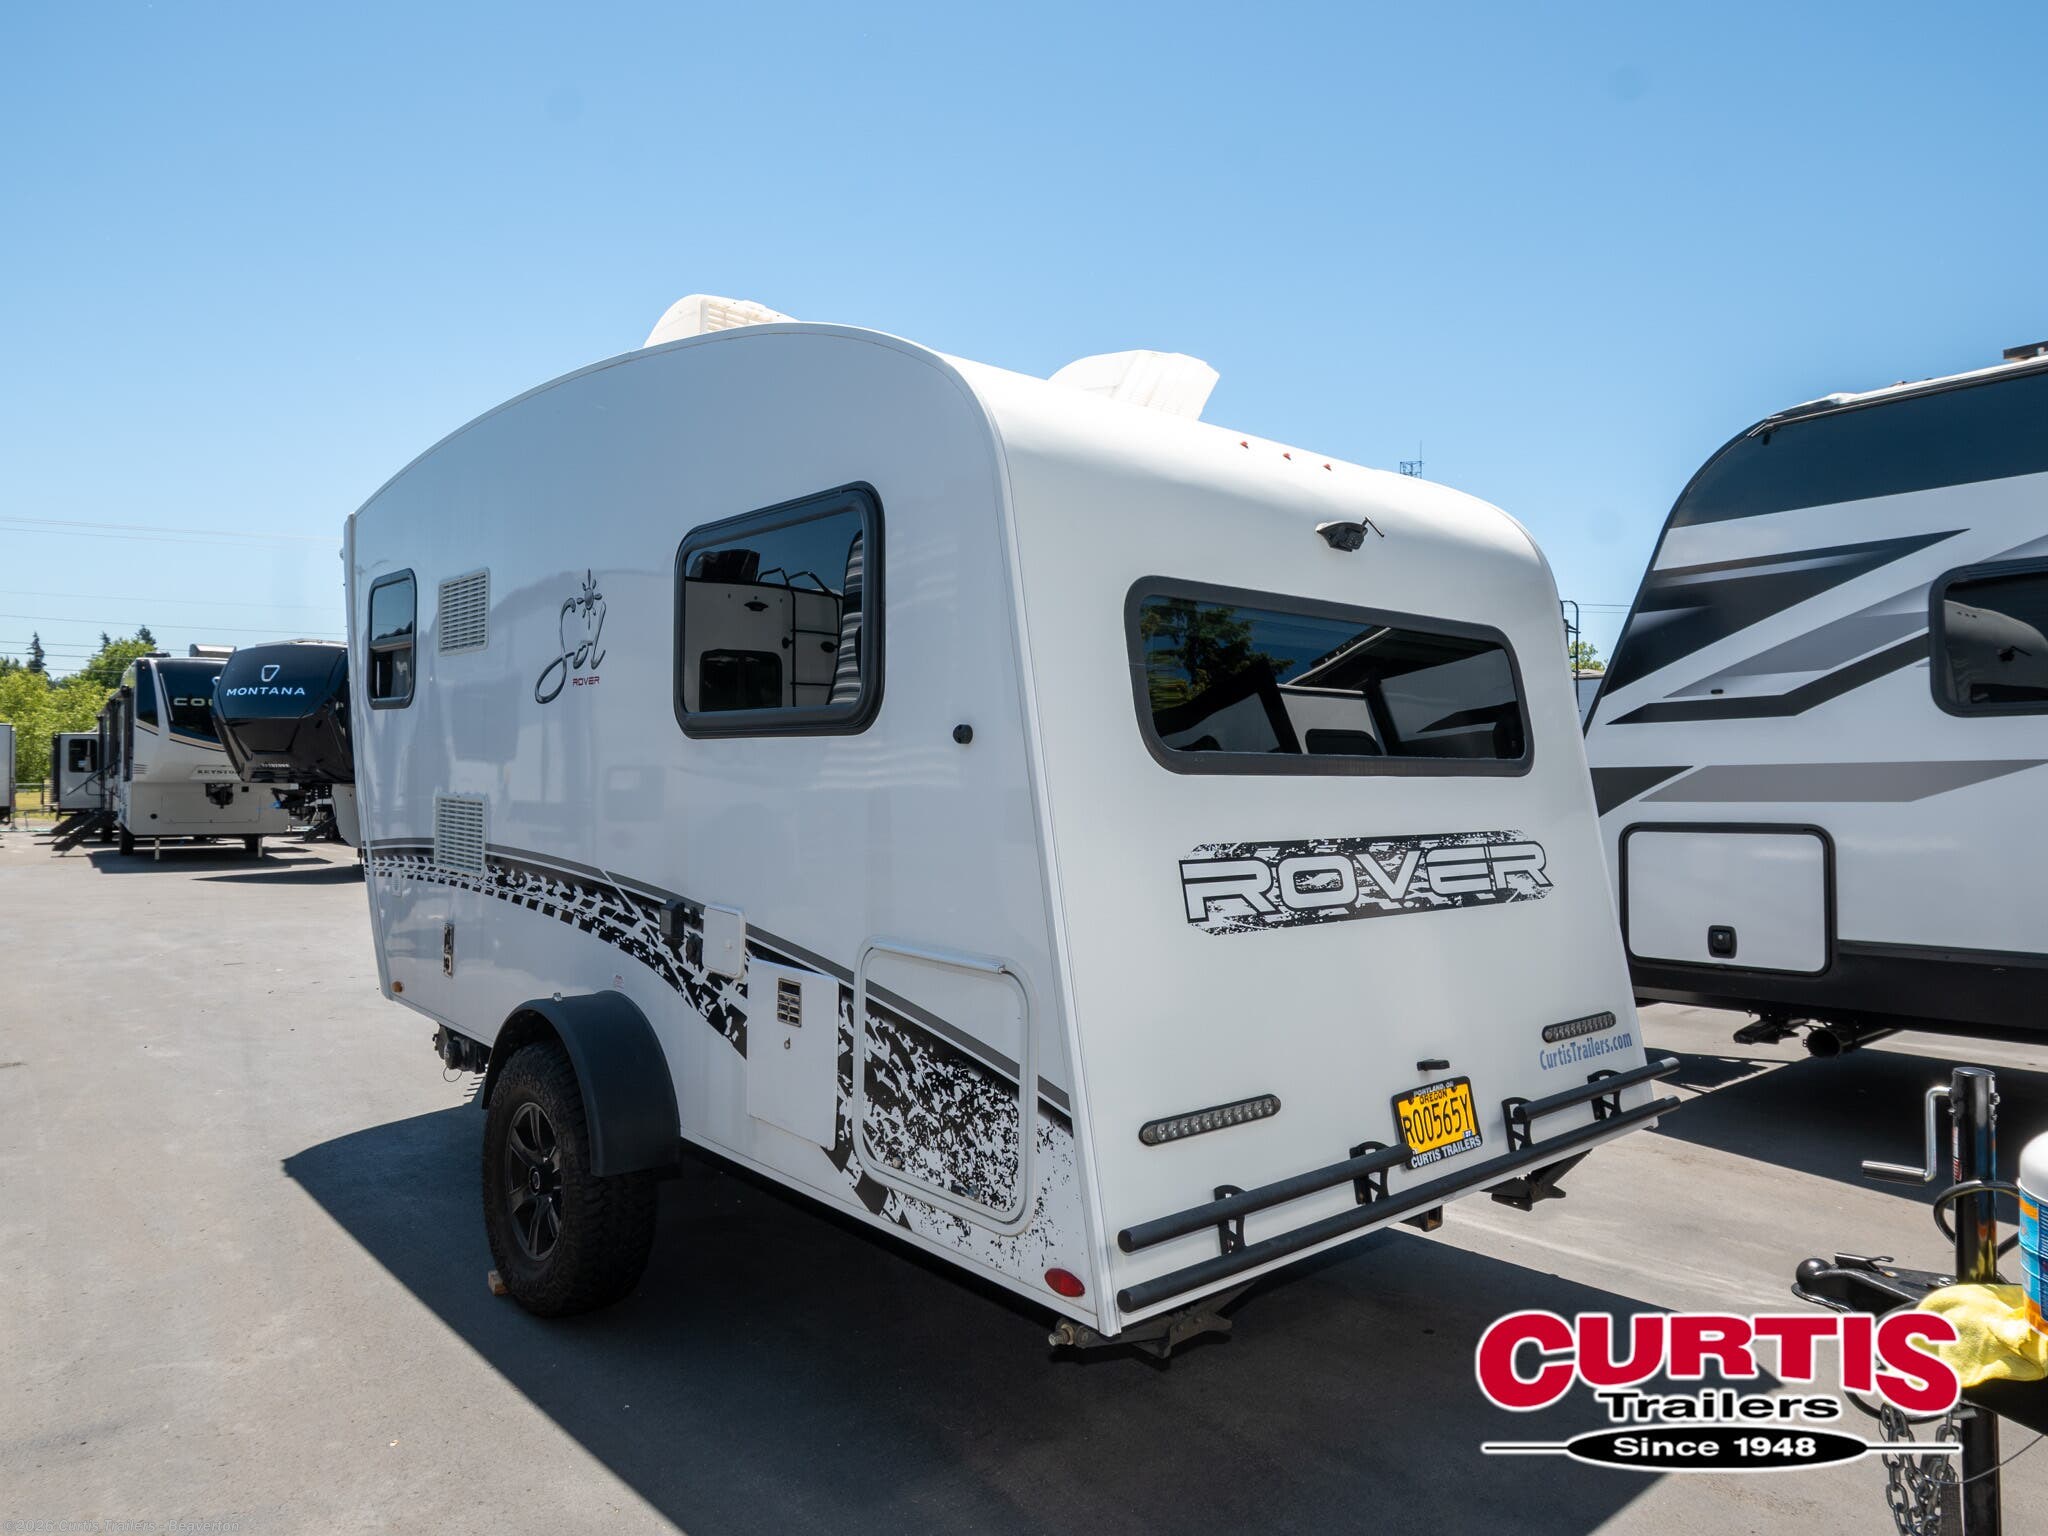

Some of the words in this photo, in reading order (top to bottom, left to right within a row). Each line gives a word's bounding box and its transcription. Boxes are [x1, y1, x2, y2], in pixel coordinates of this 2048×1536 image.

[226, 687, 306, 697] MONTANA
[572, 676, 600, 686] ROVER
[1179, 840, 1554, 924] ROVER
[1540, 1032, 1633, 1070] CurtisTrailers.com
[1419, 1090, 1448, 1104] OREGON
[1402, 1093, 1470, 1145] R00565Y
[1411, 1149, 1442, 1168] CURTIS
[1441, 1135, 1482, 1157] TRAILERS
